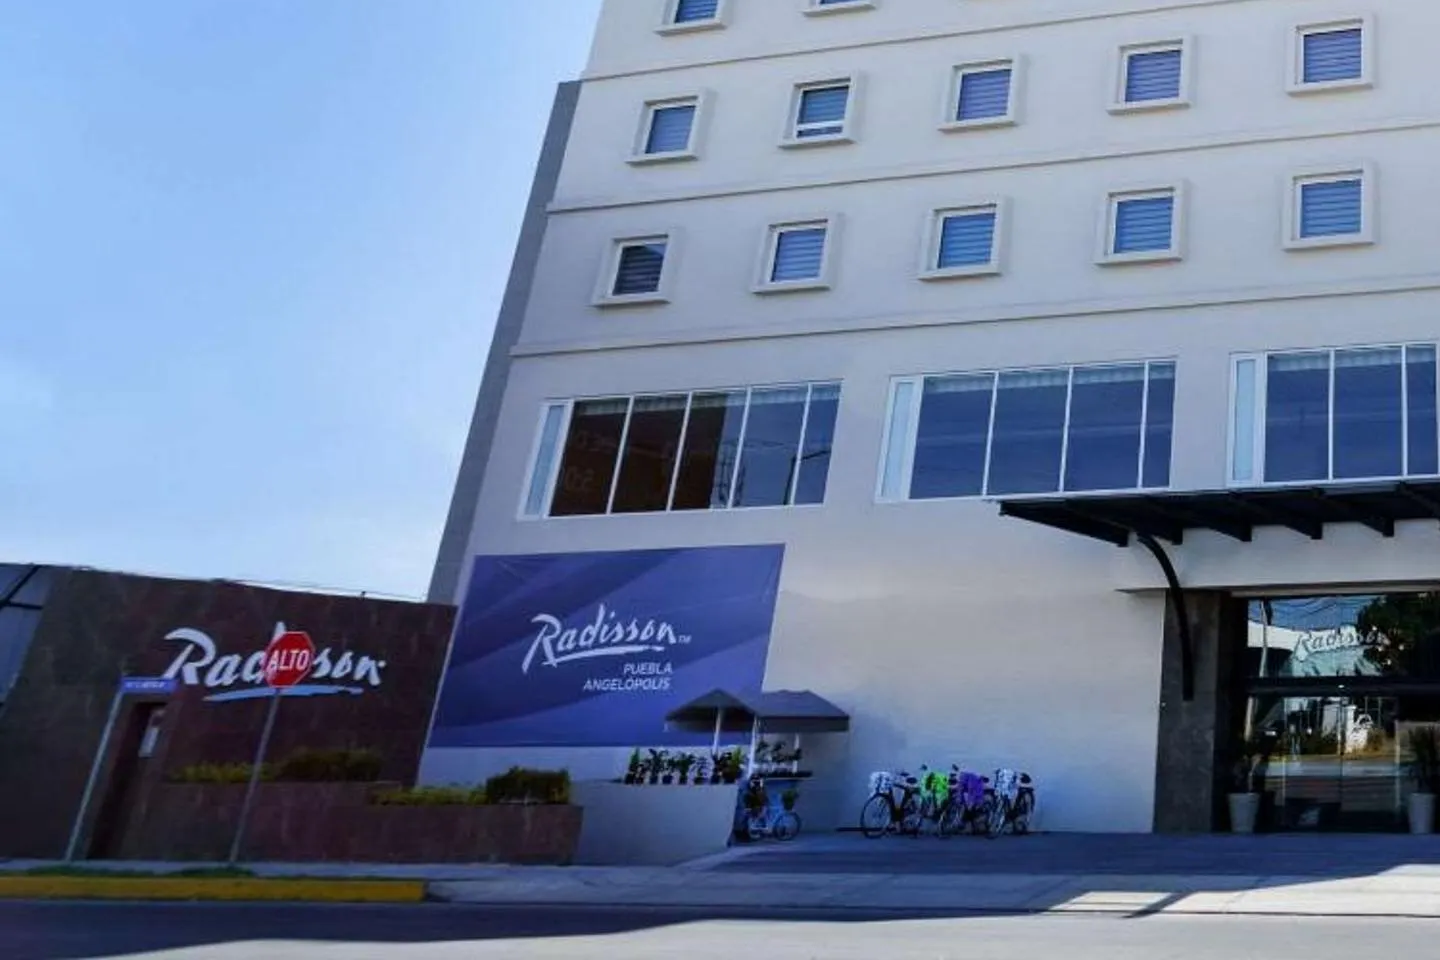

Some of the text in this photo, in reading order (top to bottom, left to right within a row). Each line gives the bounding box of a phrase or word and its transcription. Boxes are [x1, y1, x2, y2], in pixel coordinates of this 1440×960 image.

[522, 604, 677, 674] Radisson
[266, 649, 309, 671] ALTO
[623, 662, 673, 675] PUEBLA
[583, 676, 671, 691] ANGELÓPOLIS
